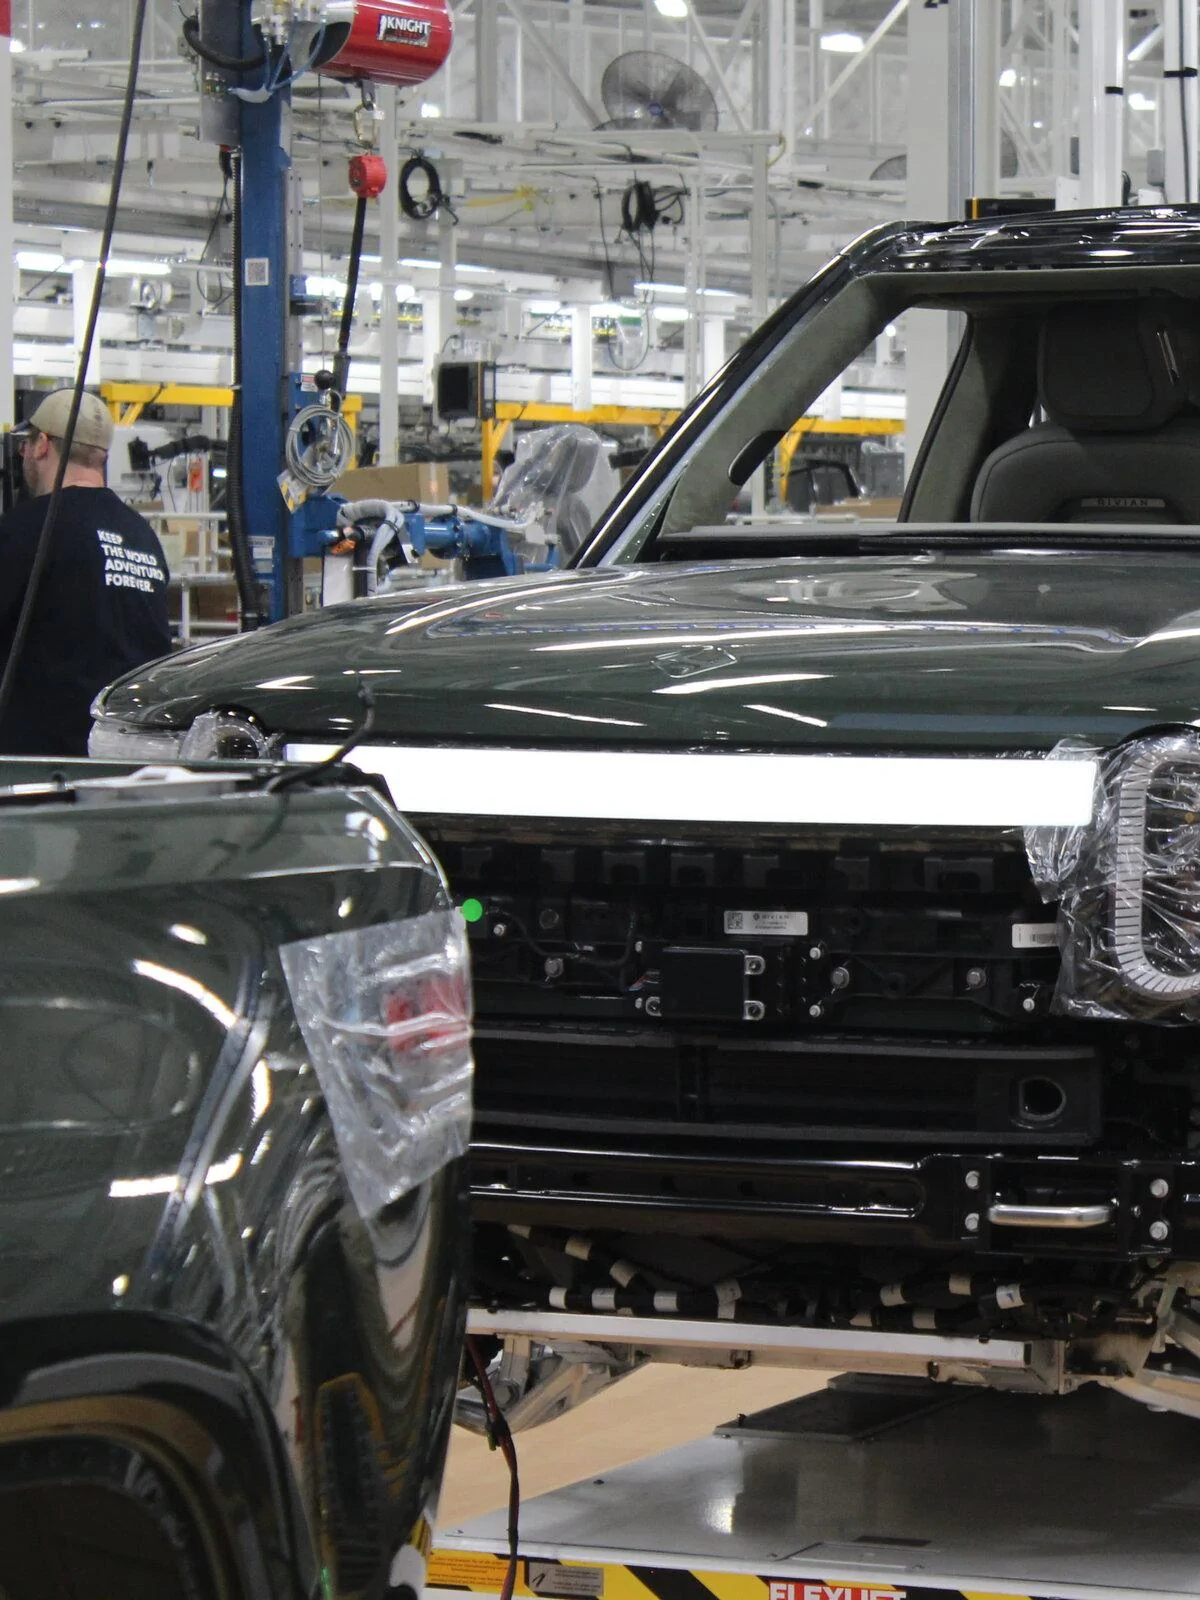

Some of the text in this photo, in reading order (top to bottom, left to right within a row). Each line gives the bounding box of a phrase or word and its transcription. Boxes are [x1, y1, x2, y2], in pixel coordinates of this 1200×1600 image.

[386, 16, 431, 34] KNIGHT
[1098, 498, 1148, 506] RIVIAN
[97, 529, 123, 545] KEEP
[101, 543, 157, 566] THE WORLD
[105, 558, 165, 581] ADVENTURO
